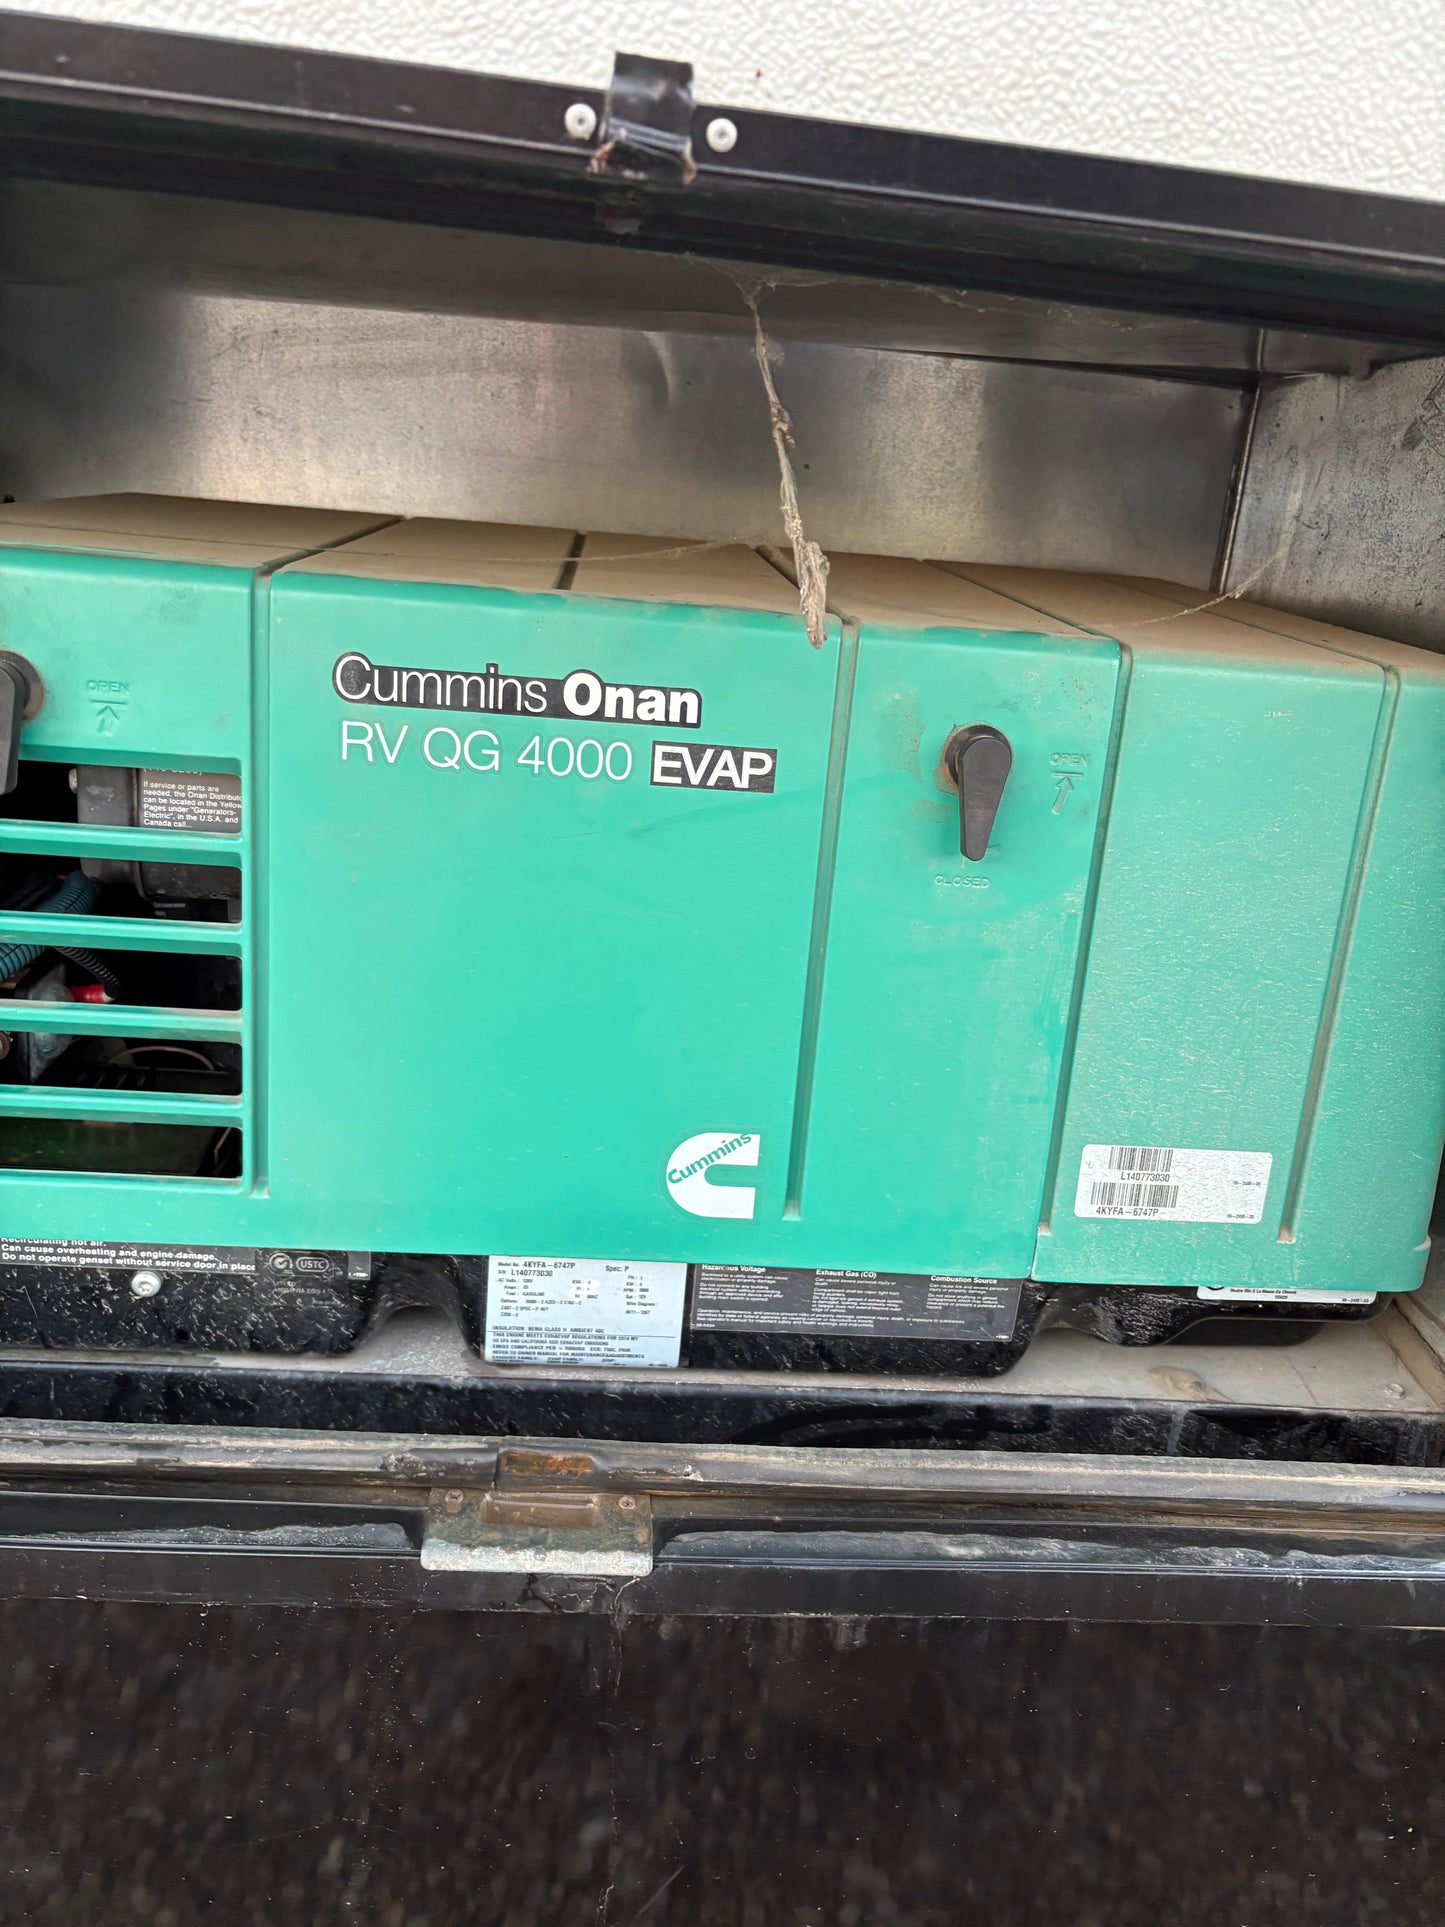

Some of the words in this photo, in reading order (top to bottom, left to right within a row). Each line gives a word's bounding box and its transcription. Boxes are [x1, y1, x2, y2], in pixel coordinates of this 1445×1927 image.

[87, 680, 129, 693] OPEN
[335, 654, 548, 714] Cummins
[563, 671, 698, 724] Onan
[341, 720, 409, 764] RV
[423, 726, 500, 772] QG
[517, 735, 632, 780] 4000
[653, 744, 773, 789] EVAP
[1050, 752, 1088, 766] OPEN
[187, 784, 205, 792] parts
[187, 791, 208, 799] Onan
[169, 798, 196, 806] located
[143, 804, 166, 812] Pages
[186, 813, 197, 821] the
[934, 874, 990, 889] CLOSED
[667, 1133, 752, 1184] Cummins
[1120, 1172, 1170, 1182] L140773030
[1, 1243, 21, 1252] Can
[24, 1246, 54, 1254] cause
[56, 1247, 116, 1257] overheating
[140, 1251, 173, 1259] engine
[2, 1252, 16, 1260] Do
[19, 1253, 36, 1261] not
[38, 1255, 76, 1263] operate
[79, 1256, 113, 1265] genset
[116, 1258, 153, 1266] without
[155, 1260, 191, 1268] service
[193, 1260, 216, 1269] door
[511, 1269, 554, 1277] L140773030
[740, 1265, 766, 1273] Voltage
[930, 1275, 972, 1283] Combustion
[973, 1277, 998, 1285] Source
